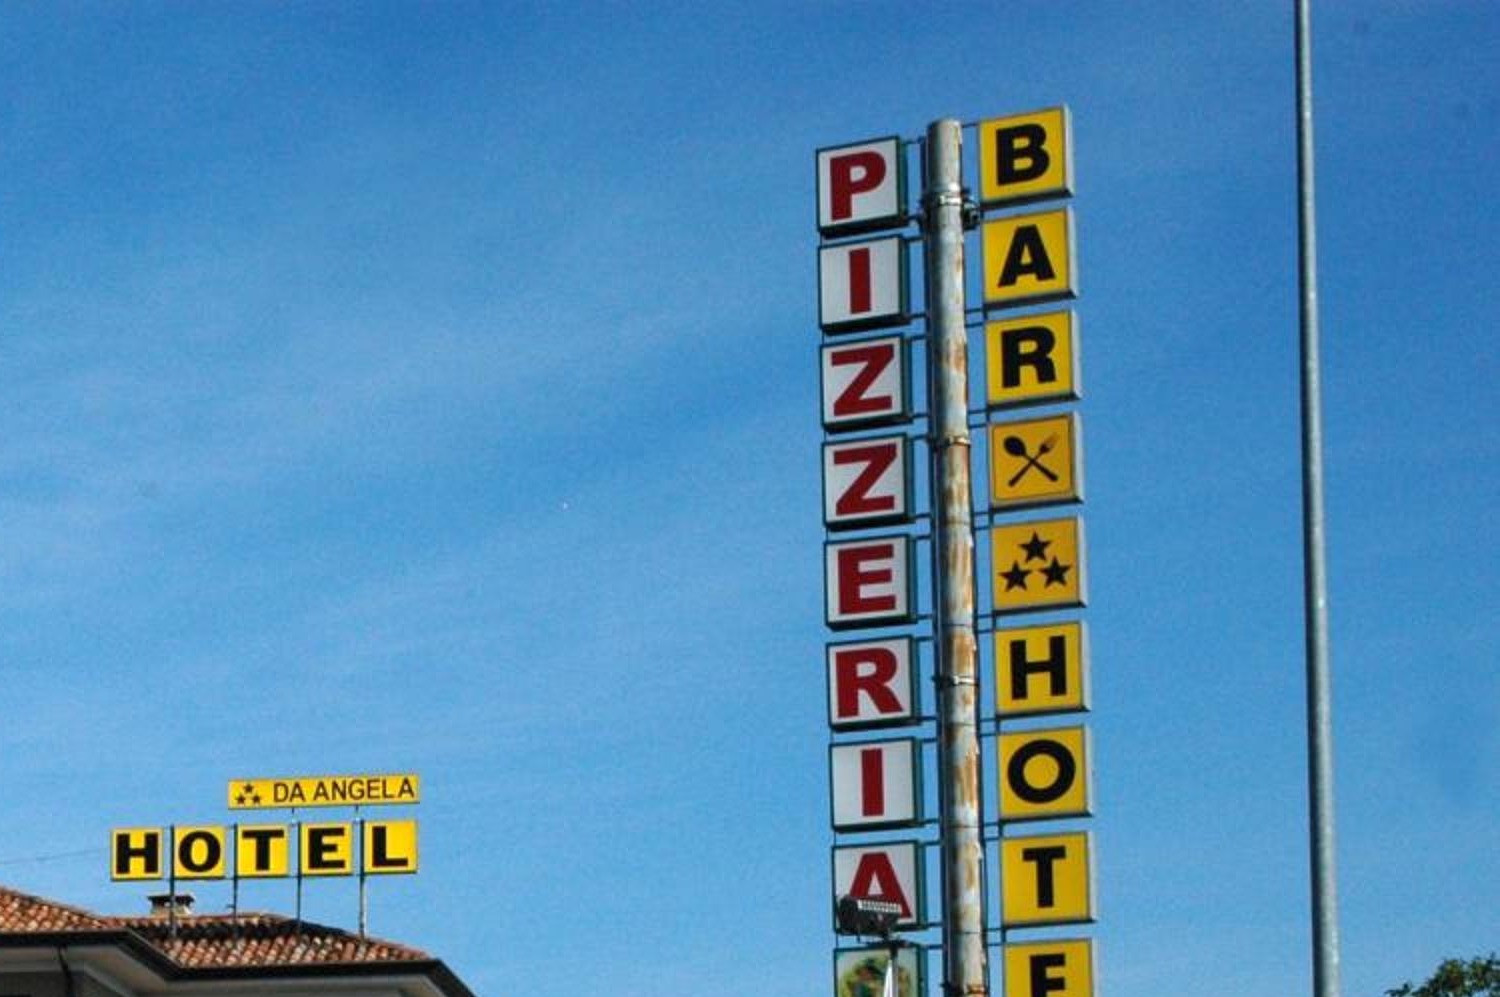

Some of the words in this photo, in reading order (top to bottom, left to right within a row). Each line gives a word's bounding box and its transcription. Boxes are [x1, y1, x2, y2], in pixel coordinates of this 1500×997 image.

[996, 123, 1057, 389] BAR
[829, 151, 913, 919] PIZZERIA
[115, 825, 410, 875] HOTEL
[273, 782, 305, 803] DA
[313, 778, 416, 802] ANGELA
